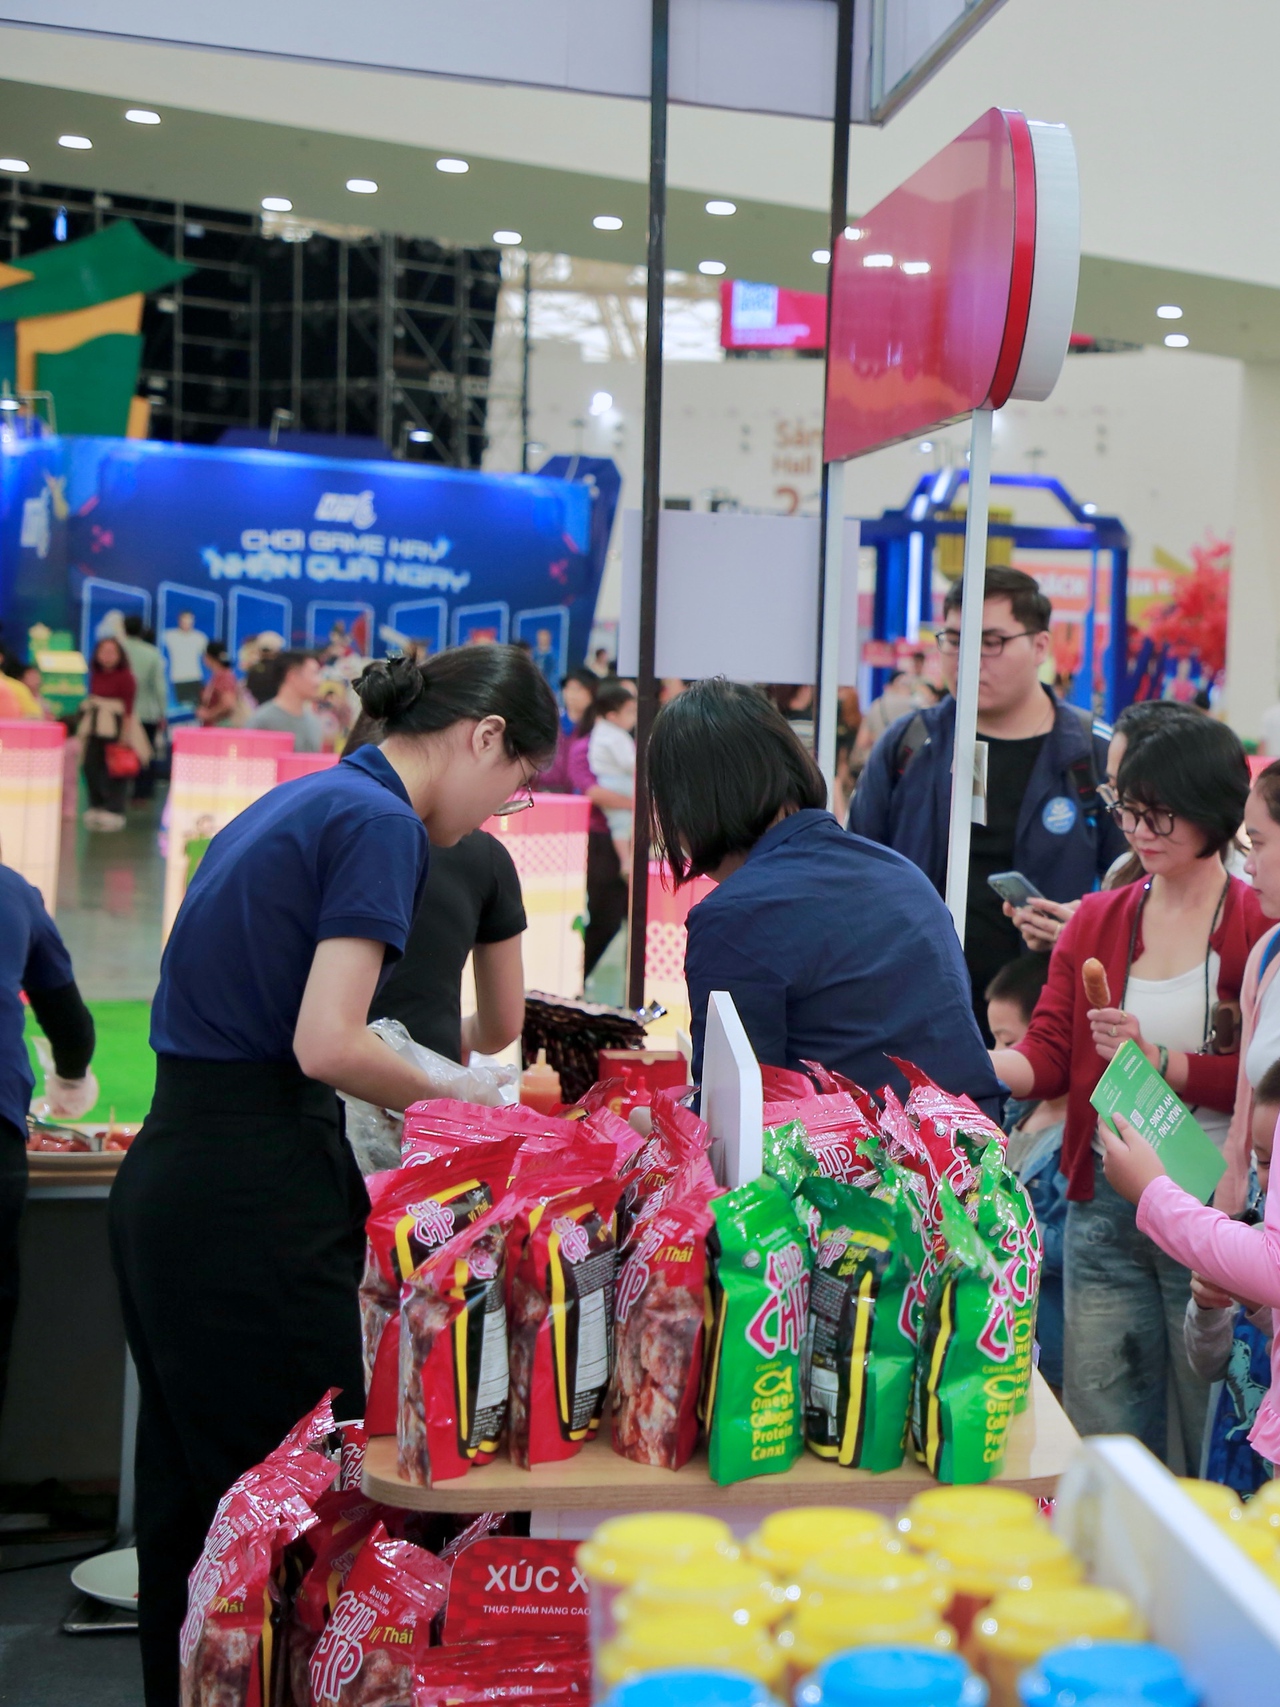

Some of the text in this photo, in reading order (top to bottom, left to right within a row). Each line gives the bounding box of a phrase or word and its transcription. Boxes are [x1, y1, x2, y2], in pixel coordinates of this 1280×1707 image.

[308, 530, 386, 556] GAME
[388, 536, 450, 563] HAY
[406, 1199, 442, 1220] CHIP
[414, 1207, 456, 1247] CHIP
[560, 1225, 590, 1264] CHIP
[665, 1245, 694, 1263] Thái
[764, 1240, 803, 1295] CHIP
[745, 1269, 812, 1360] CHIP
[751, 1392, 795, 1412] Omega
[752, 1424, 793, 1445] Protein
[751, 1440, 785, 1461] Canxi
[483, 1559, 560, 1593] XÚC
[483, 1604, 510, 1616] THỰC
[570, 1607, 591, 1616] CAO
[382, 1626, 414, 1645] Thái
[309, 1622, 364, 1703] HIP
